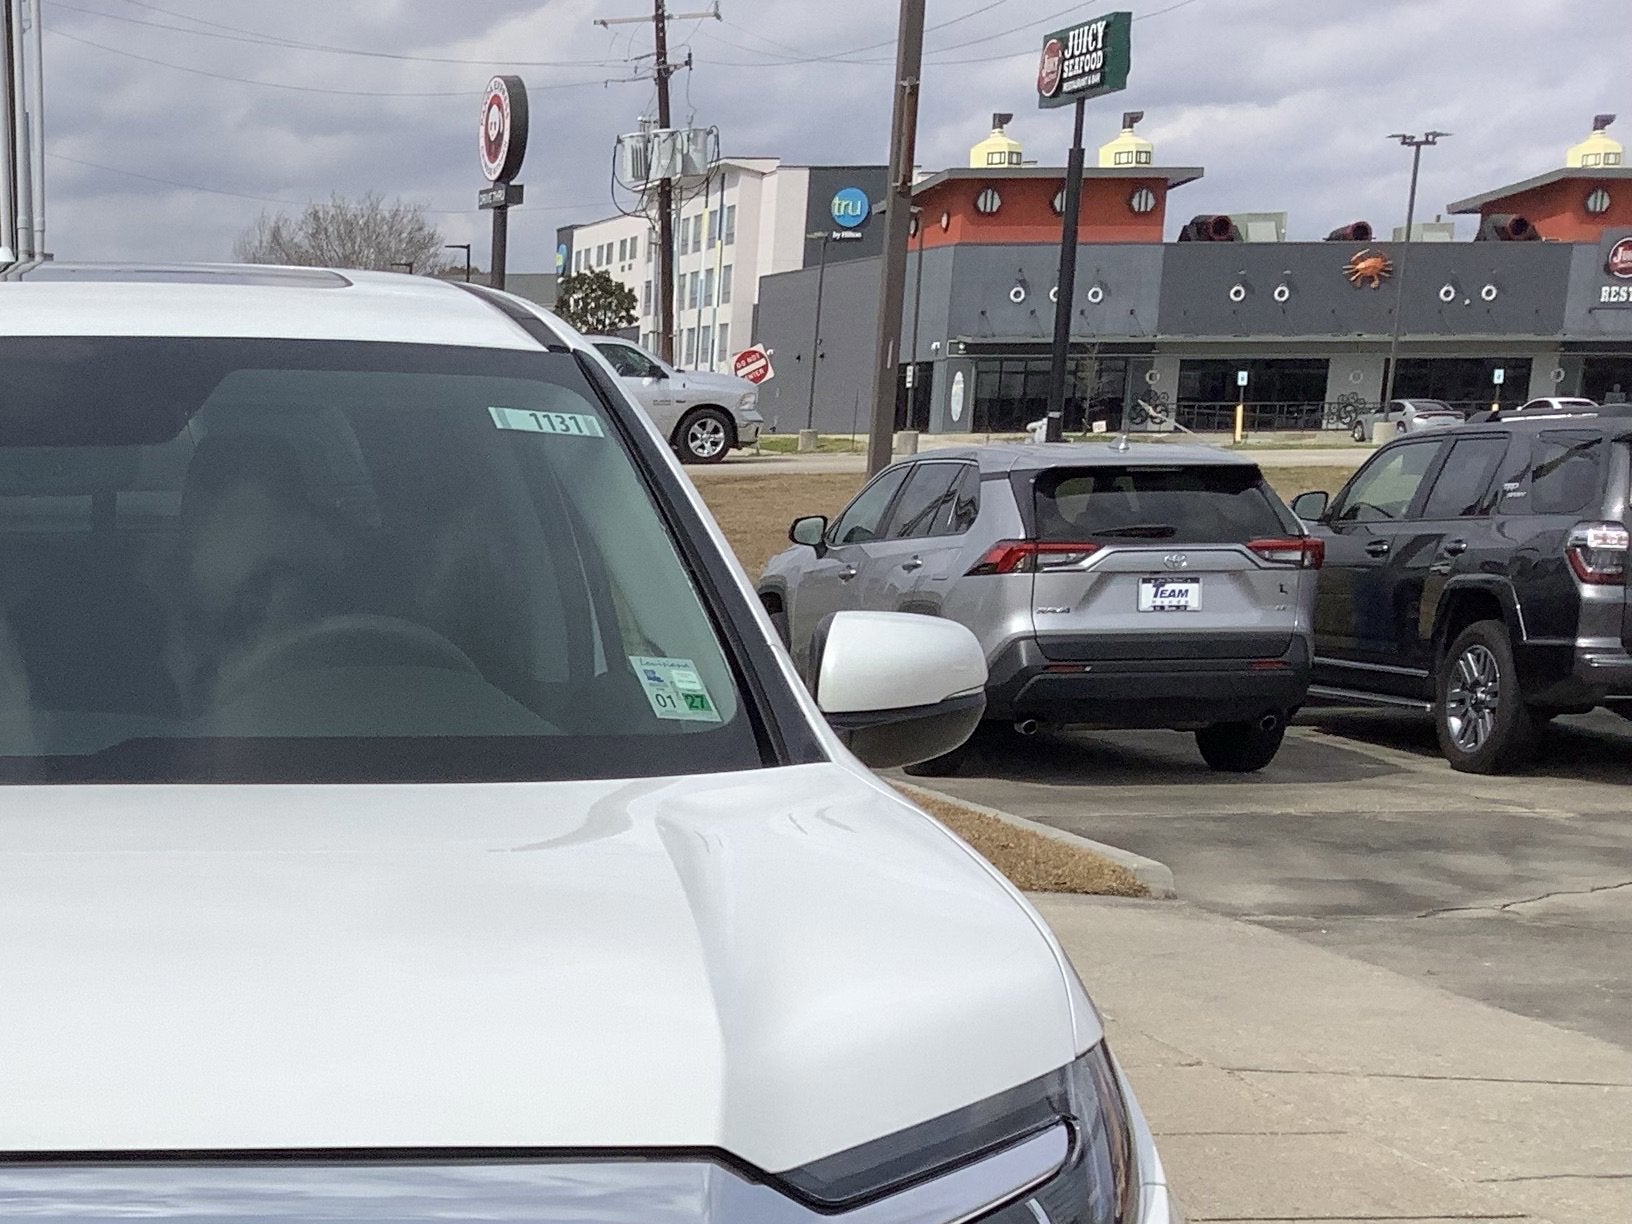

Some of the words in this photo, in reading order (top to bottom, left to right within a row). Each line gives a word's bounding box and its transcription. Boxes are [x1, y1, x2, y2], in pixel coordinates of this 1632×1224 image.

[1064, 20, 1107, 59] JUICY
[1063, 50, 1104, 78] SEAFOOD
[833, 195, 862, 216] tru
[529, 412, 583, 434] 1131
[1152, 581, 1189, 599] TEAM
[655, 693, 677, 709] 01
[684, 693, 706, 709] 27
